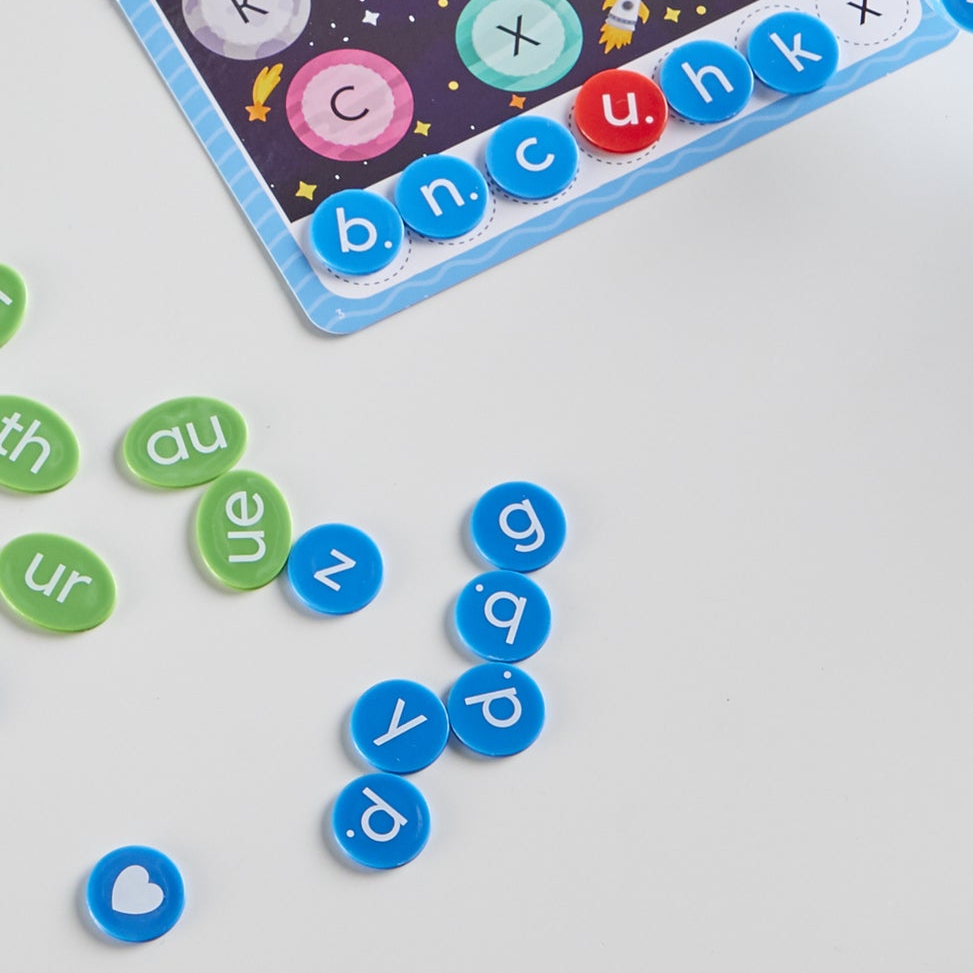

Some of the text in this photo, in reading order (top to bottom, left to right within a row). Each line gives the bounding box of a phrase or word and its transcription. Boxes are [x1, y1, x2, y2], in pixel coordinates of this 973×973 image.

[496, 15, 541, 57] X
[330, 85, 370, 122] C
[514, 137, 556, 173] c
[684, 62, 734, 104] h
[770, 34, 822, 72] k
[146, 414, 229, 467] au
[225, 490, 266, 565] ue
[498, 498, 546, 553] g
[24, 552, 93, 604] ur
[373, 698, 428, 747] y
